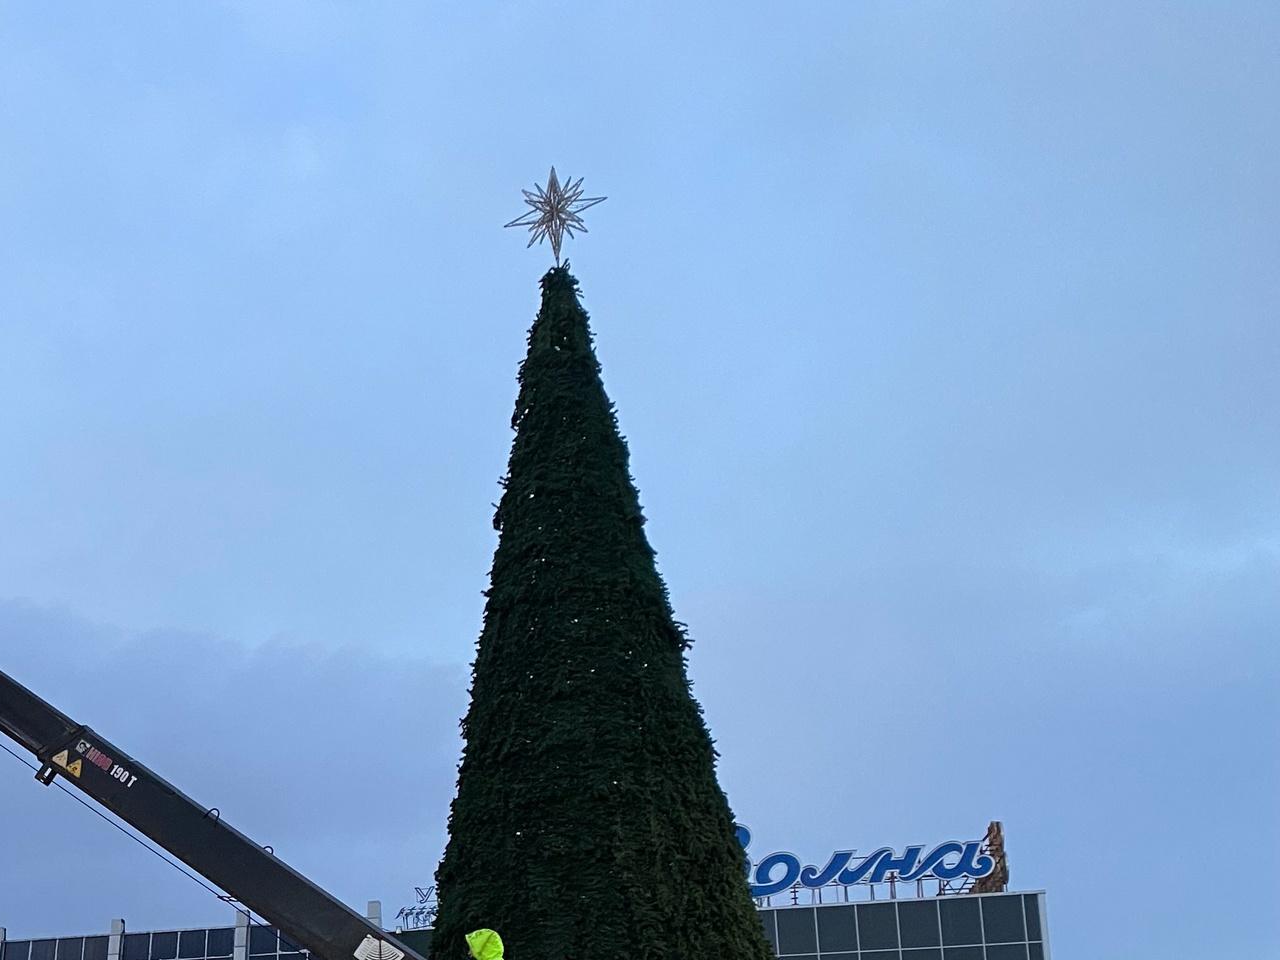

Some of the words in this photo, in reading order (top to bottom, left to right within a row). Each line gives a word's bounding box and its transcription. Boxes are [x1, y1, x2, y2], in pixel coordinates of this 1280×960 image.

[110, 764, 129, 783] 190
[127, 775, 138, 788] T
[735, 823, 996, 898] олна
